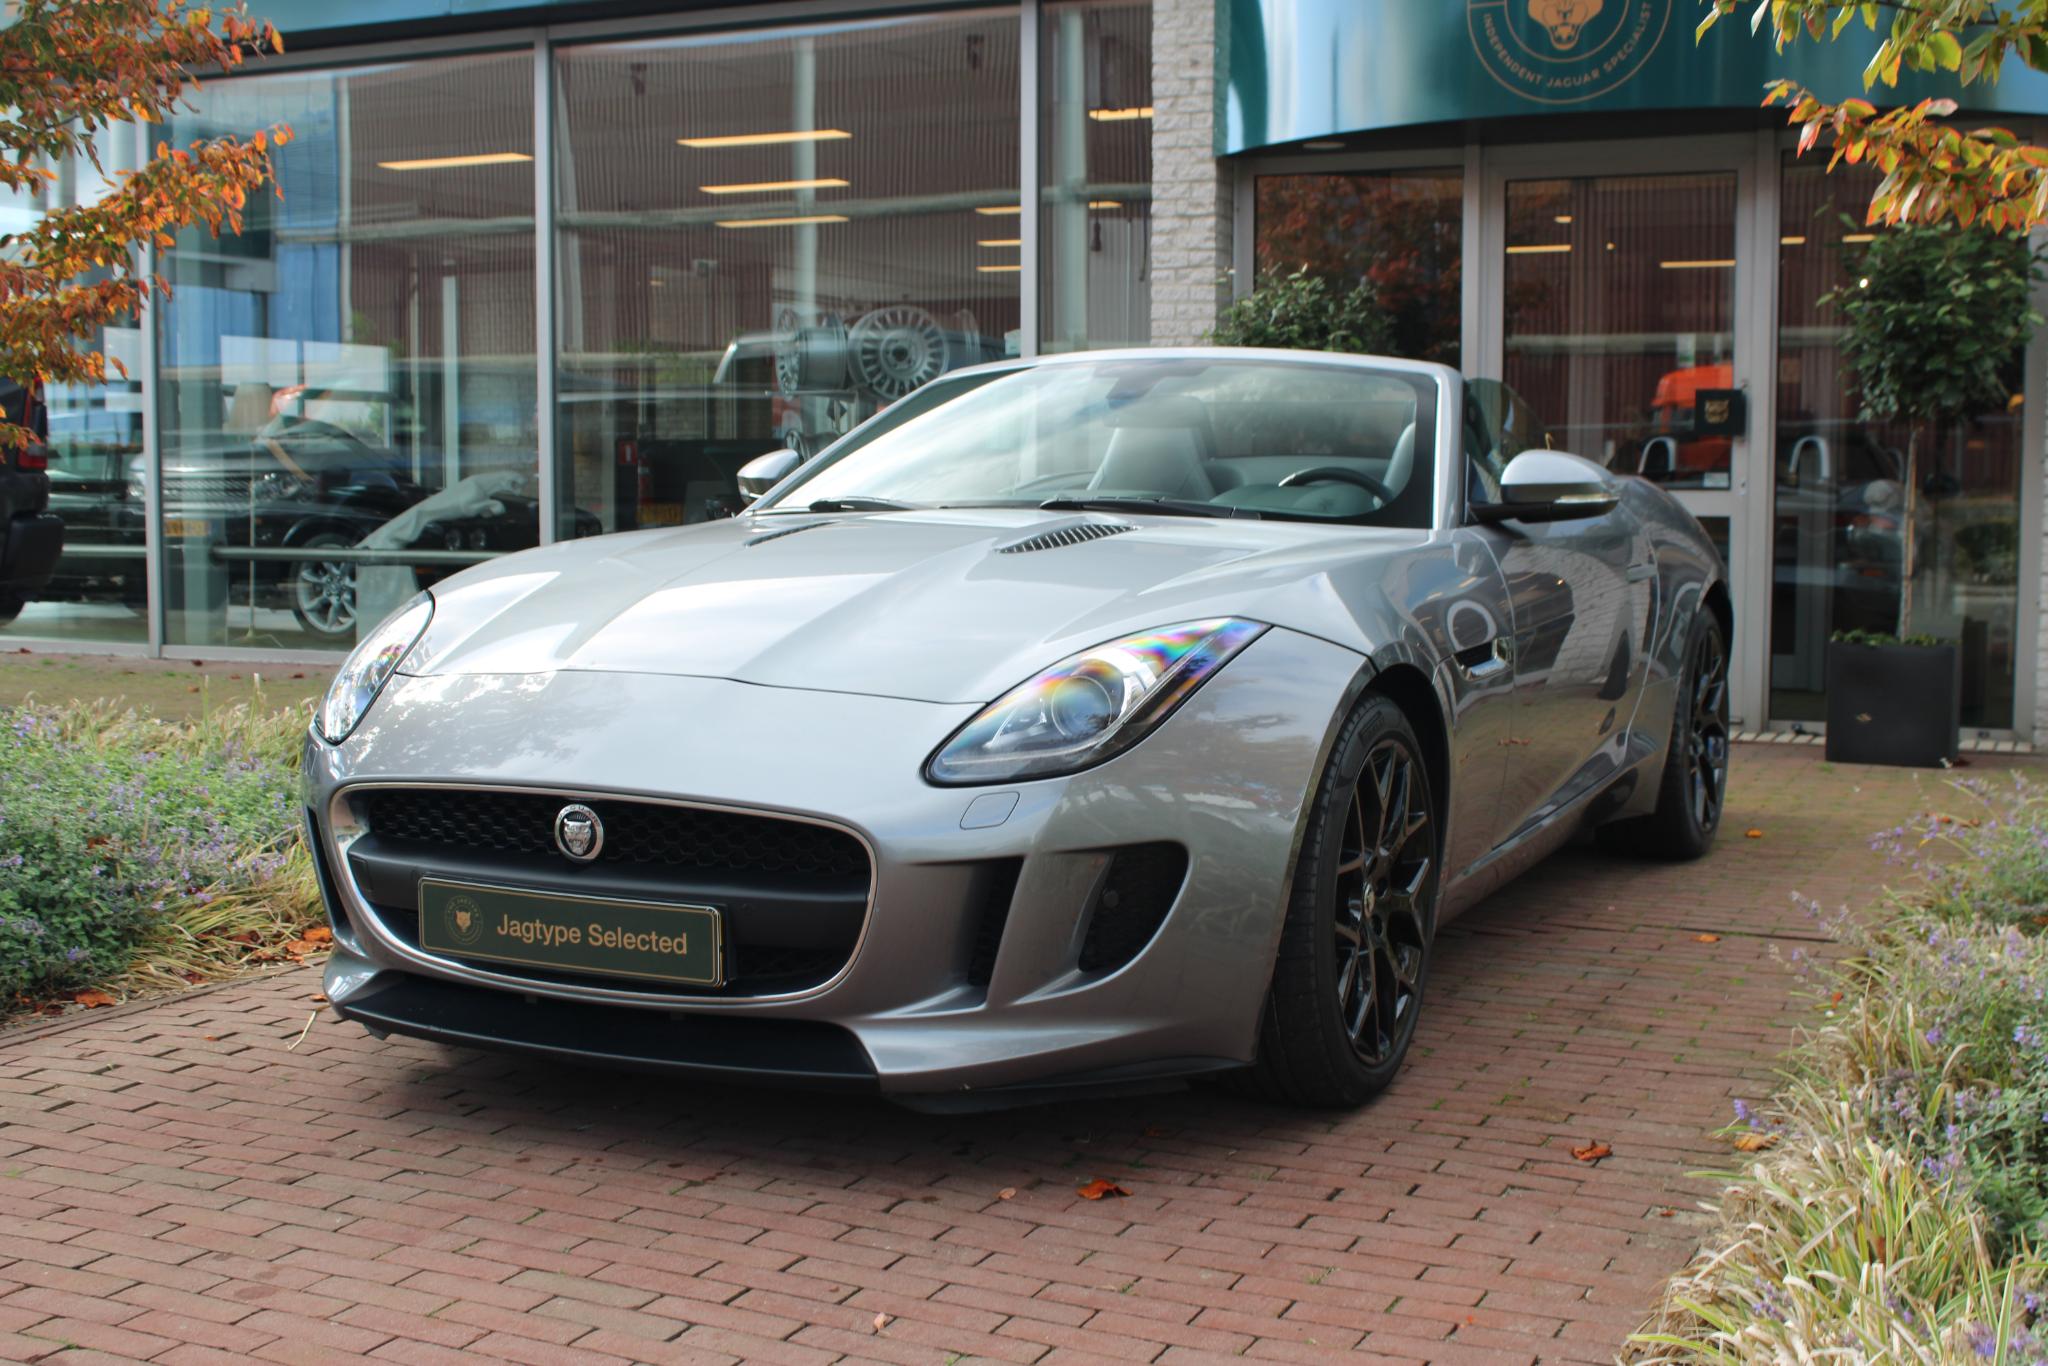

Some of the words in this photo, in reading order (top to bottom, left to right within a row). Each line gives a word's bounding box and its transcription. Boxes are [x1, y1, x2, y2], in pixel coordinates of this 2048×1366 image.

[1483, 13, 1542, 85] INDEPENDENT
[1546, 69, 1600, 88] JAGUAR
[1603, 2, 1652, 72] SPECIALIST
[497, 914, 581, 946] Jagtype
[588, 923, 687, 955] Selected
